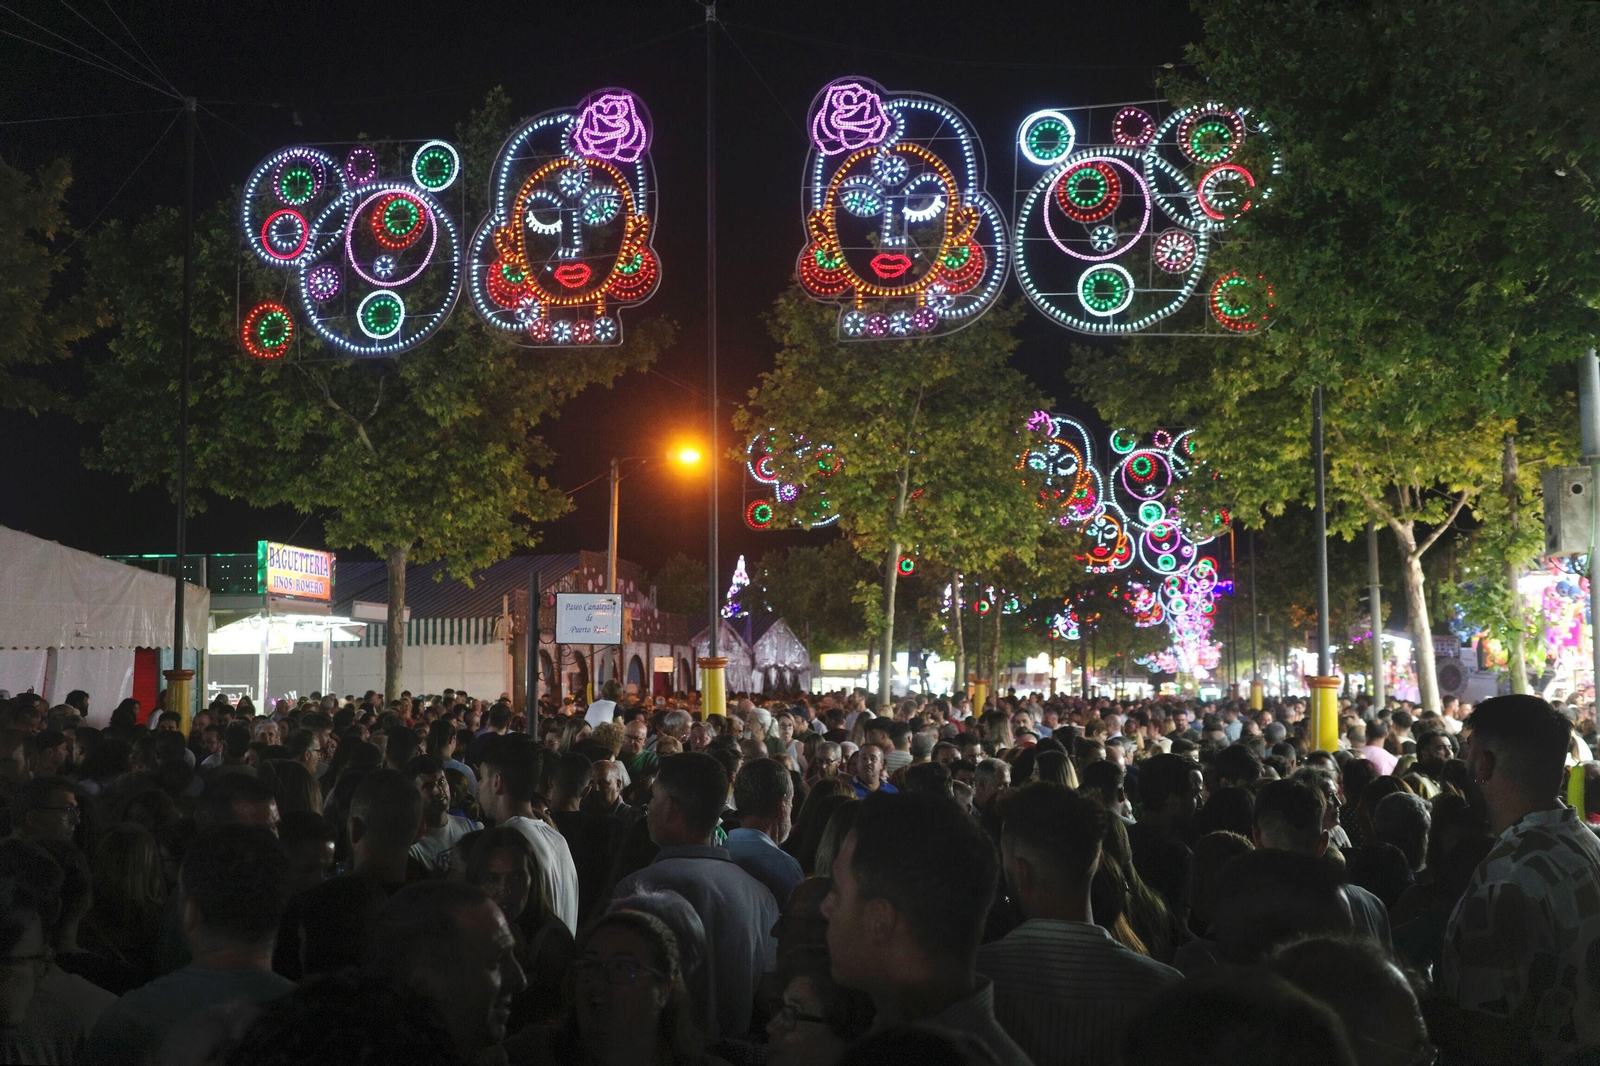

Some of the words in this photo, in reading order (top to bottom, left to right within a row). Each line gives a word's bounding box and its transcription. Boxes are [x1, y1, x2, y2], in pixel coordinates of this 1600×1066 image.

[269, 546, 329, 577] BAGUETTERIA
[273, 575, 294, 590] HNOS.
[295, 579, 324, 594] ROMERO
[565, 602, 582, 611] Paseo
[583, 602, 613, 612] Canalejas
[585, 613, 593, 622] de
[570, 625, 591, 633] Puerto
